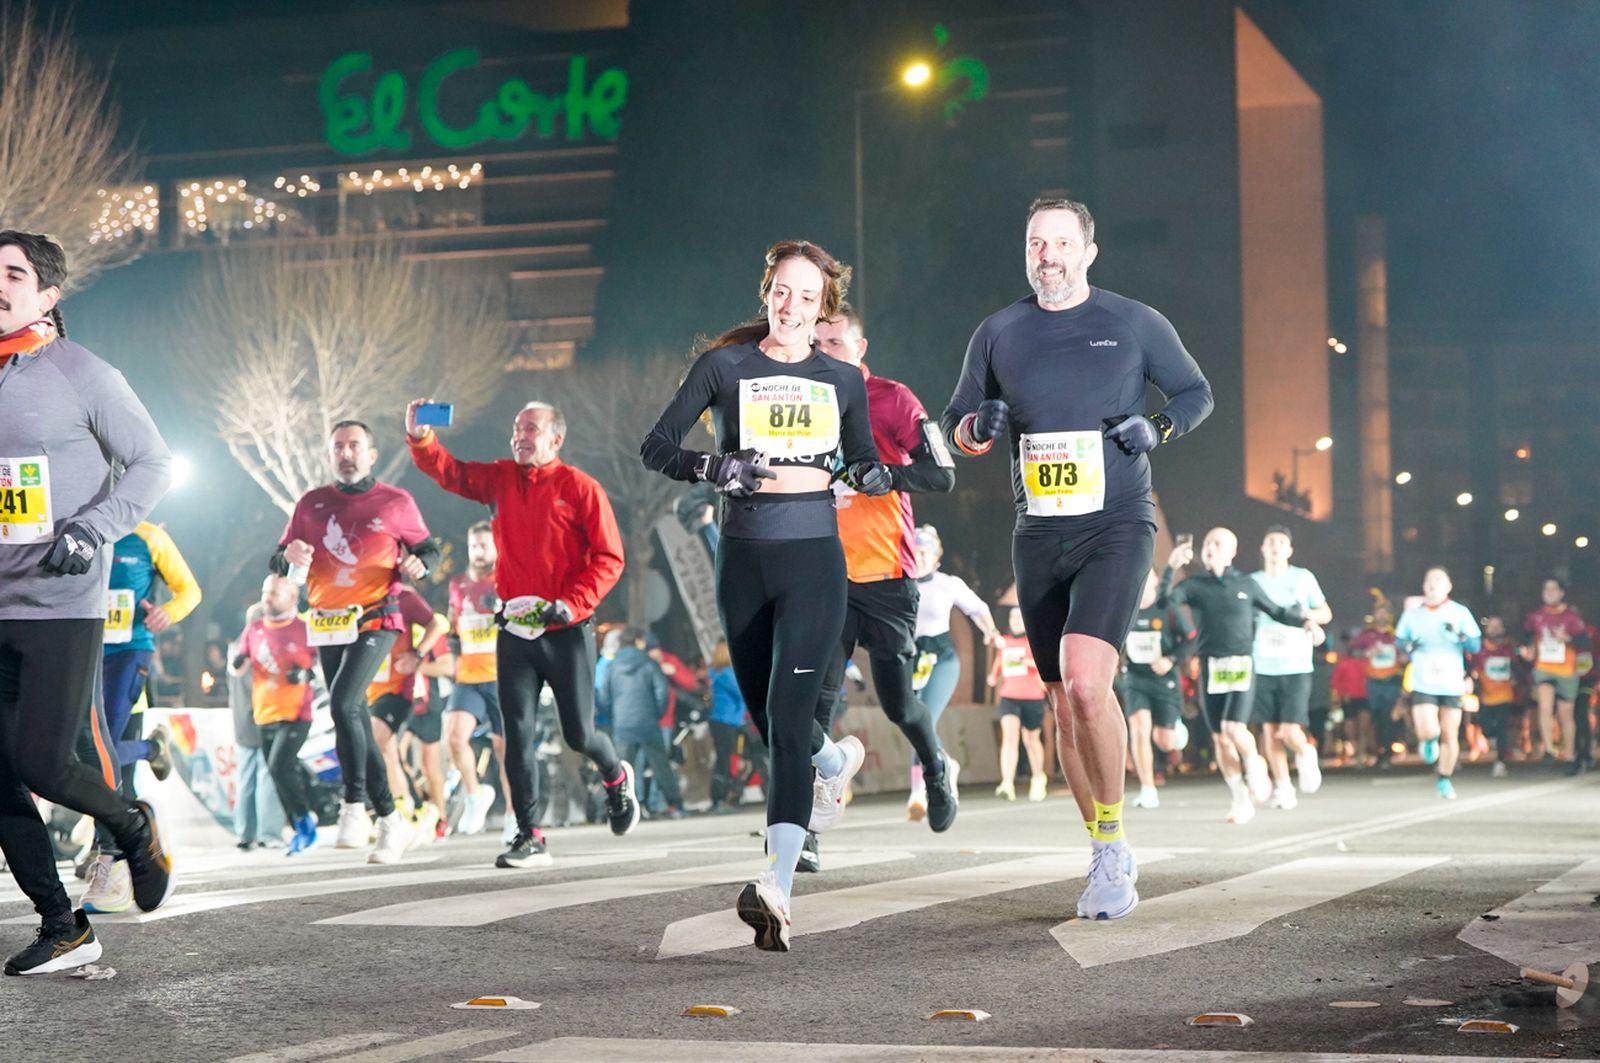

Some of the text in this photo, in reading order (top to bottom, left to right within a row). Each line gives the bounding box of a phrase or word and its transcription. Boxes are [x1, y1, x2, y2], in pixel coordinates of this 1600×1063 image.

[318, 49, 628, 156] El Corte
[762, 384, 801, 392] NOCHE DE
[752, 394, 770, 402] SAN
[769, 403, 812, 428] 874
[1031, 441, 1068, 451] NOCHE DE
[1038, 462, 1078, 488] 873
